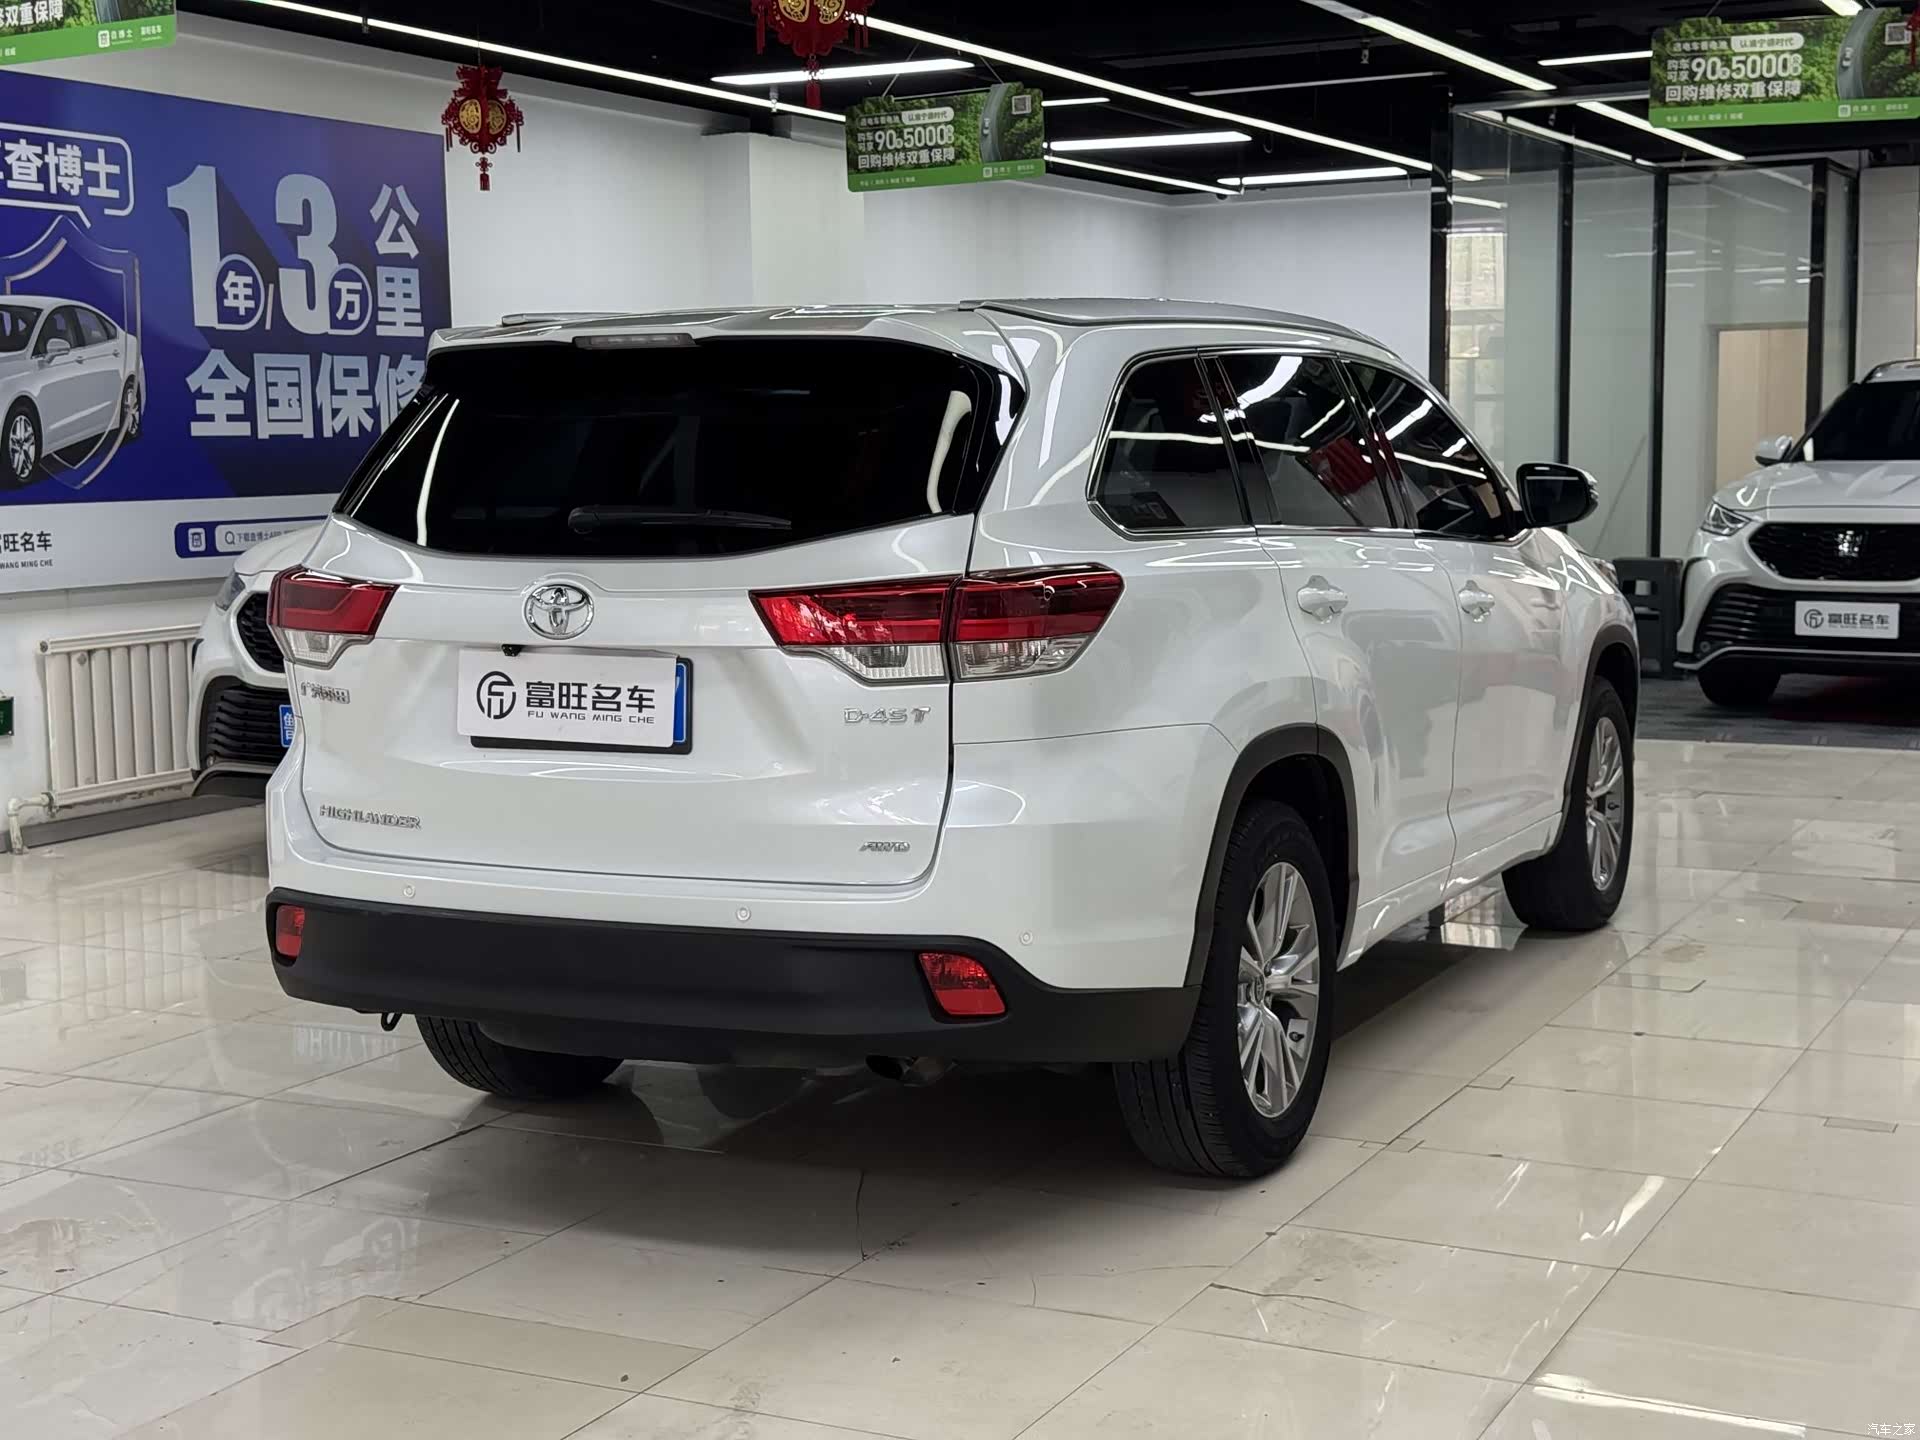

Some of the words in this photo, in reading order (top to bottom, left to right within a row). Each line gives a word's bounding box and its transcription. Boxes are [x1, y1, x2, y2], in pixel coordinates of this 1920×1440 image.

[1665, 80, 1801, 103] 回购维修双重保障
[0, 138, 121, 199] 查博士
[857, 147, 955, 169] 回购维修双重保障
[185, 349, 426, 440] 全国保修
[0, 530, 53, 553] 旺名车
[20, 560, 39, 568] MING
[39, 559, 54, 567] CHE
[1828, 613, 1890, 625] 富旺名车
[526, 681, 656, 714] 富旺名车
[527, 710, 544, 719] FU
[550, 711, 586, 721] WANG
[592, 713, 623, 723] MING
[628, 715, 655, 725] CHE
[319, 803, 421, 830] HIGHLANDER
[858, 841, 911, 853] AWD
